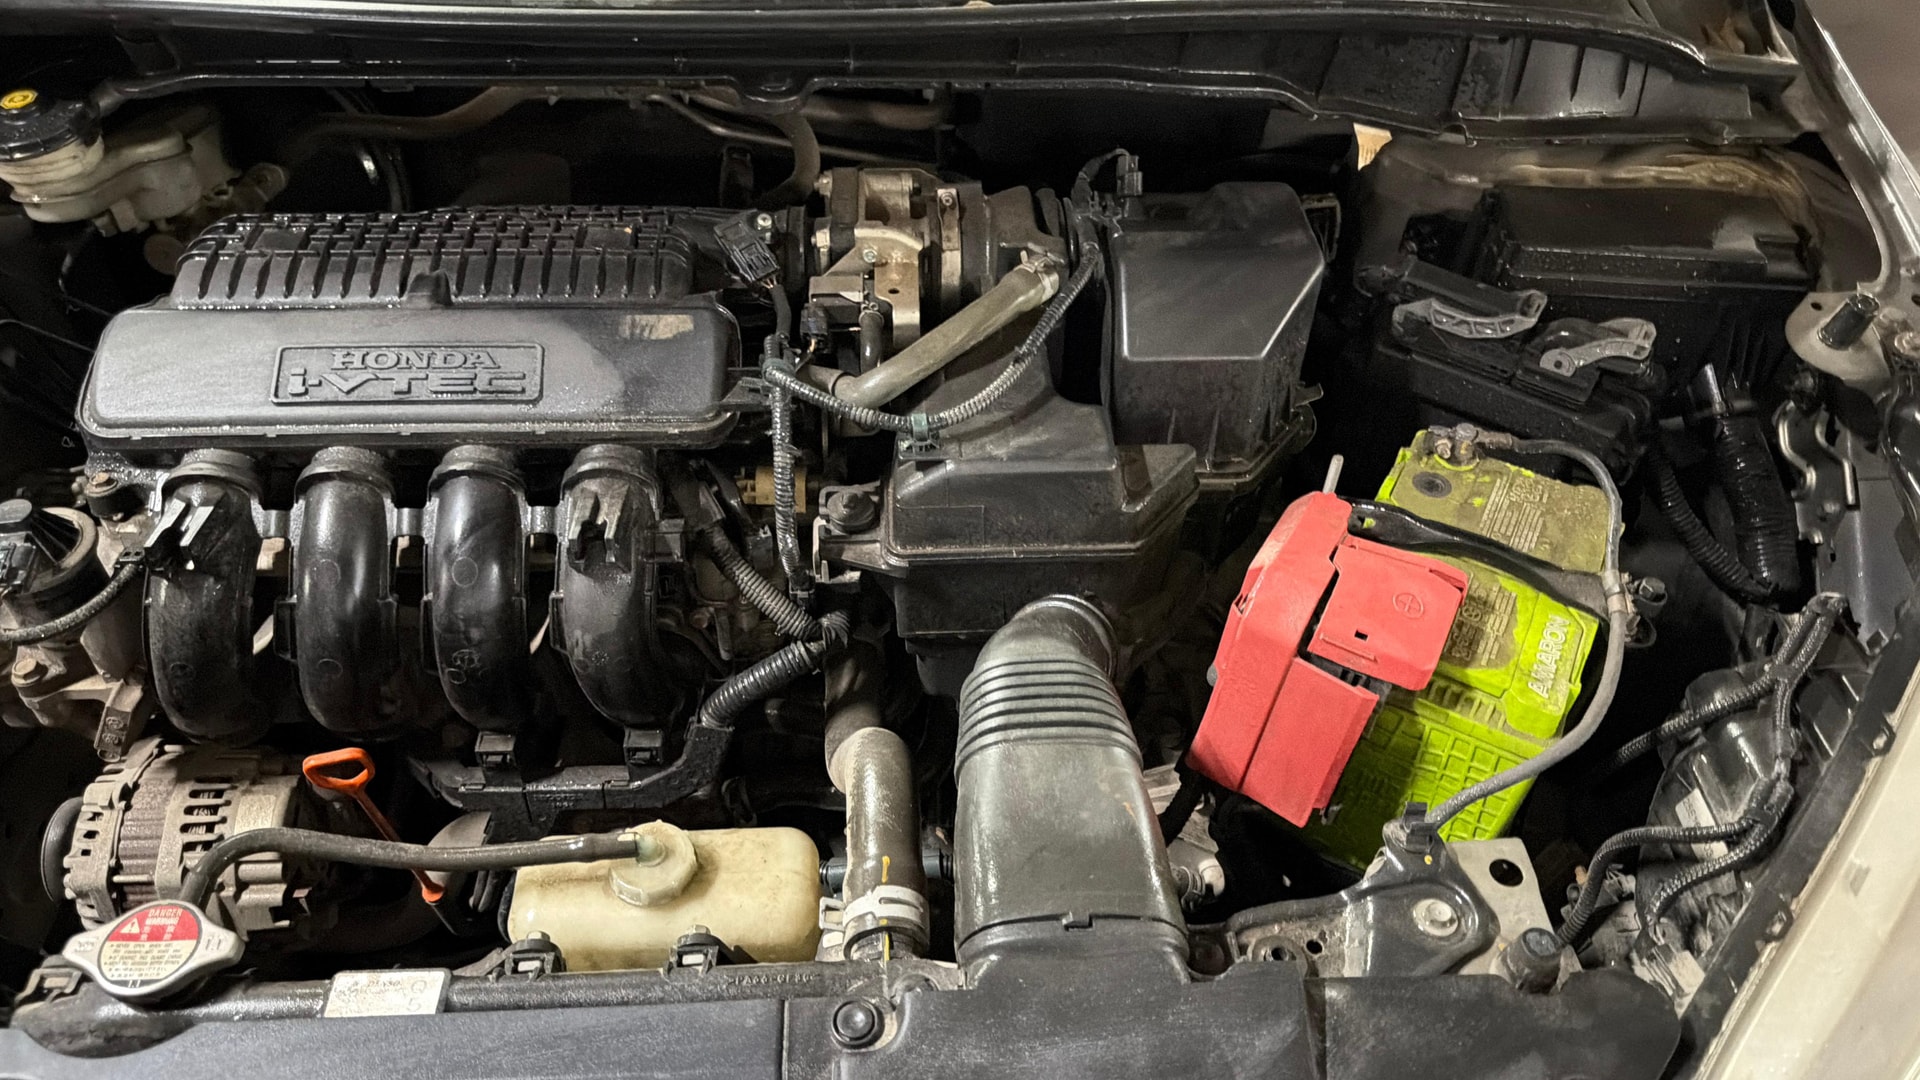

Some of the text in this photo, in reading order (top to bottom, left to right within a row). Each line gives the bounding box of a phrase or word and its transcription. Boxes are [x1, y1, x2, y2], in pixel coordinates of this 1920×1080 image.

[331, 350, 501, 371] HONDA
[288, 367, 526, 396] i-VTEC
[1528, 614, 1571, 699] AMARON
[148, 908, 183, 918] DANGER
